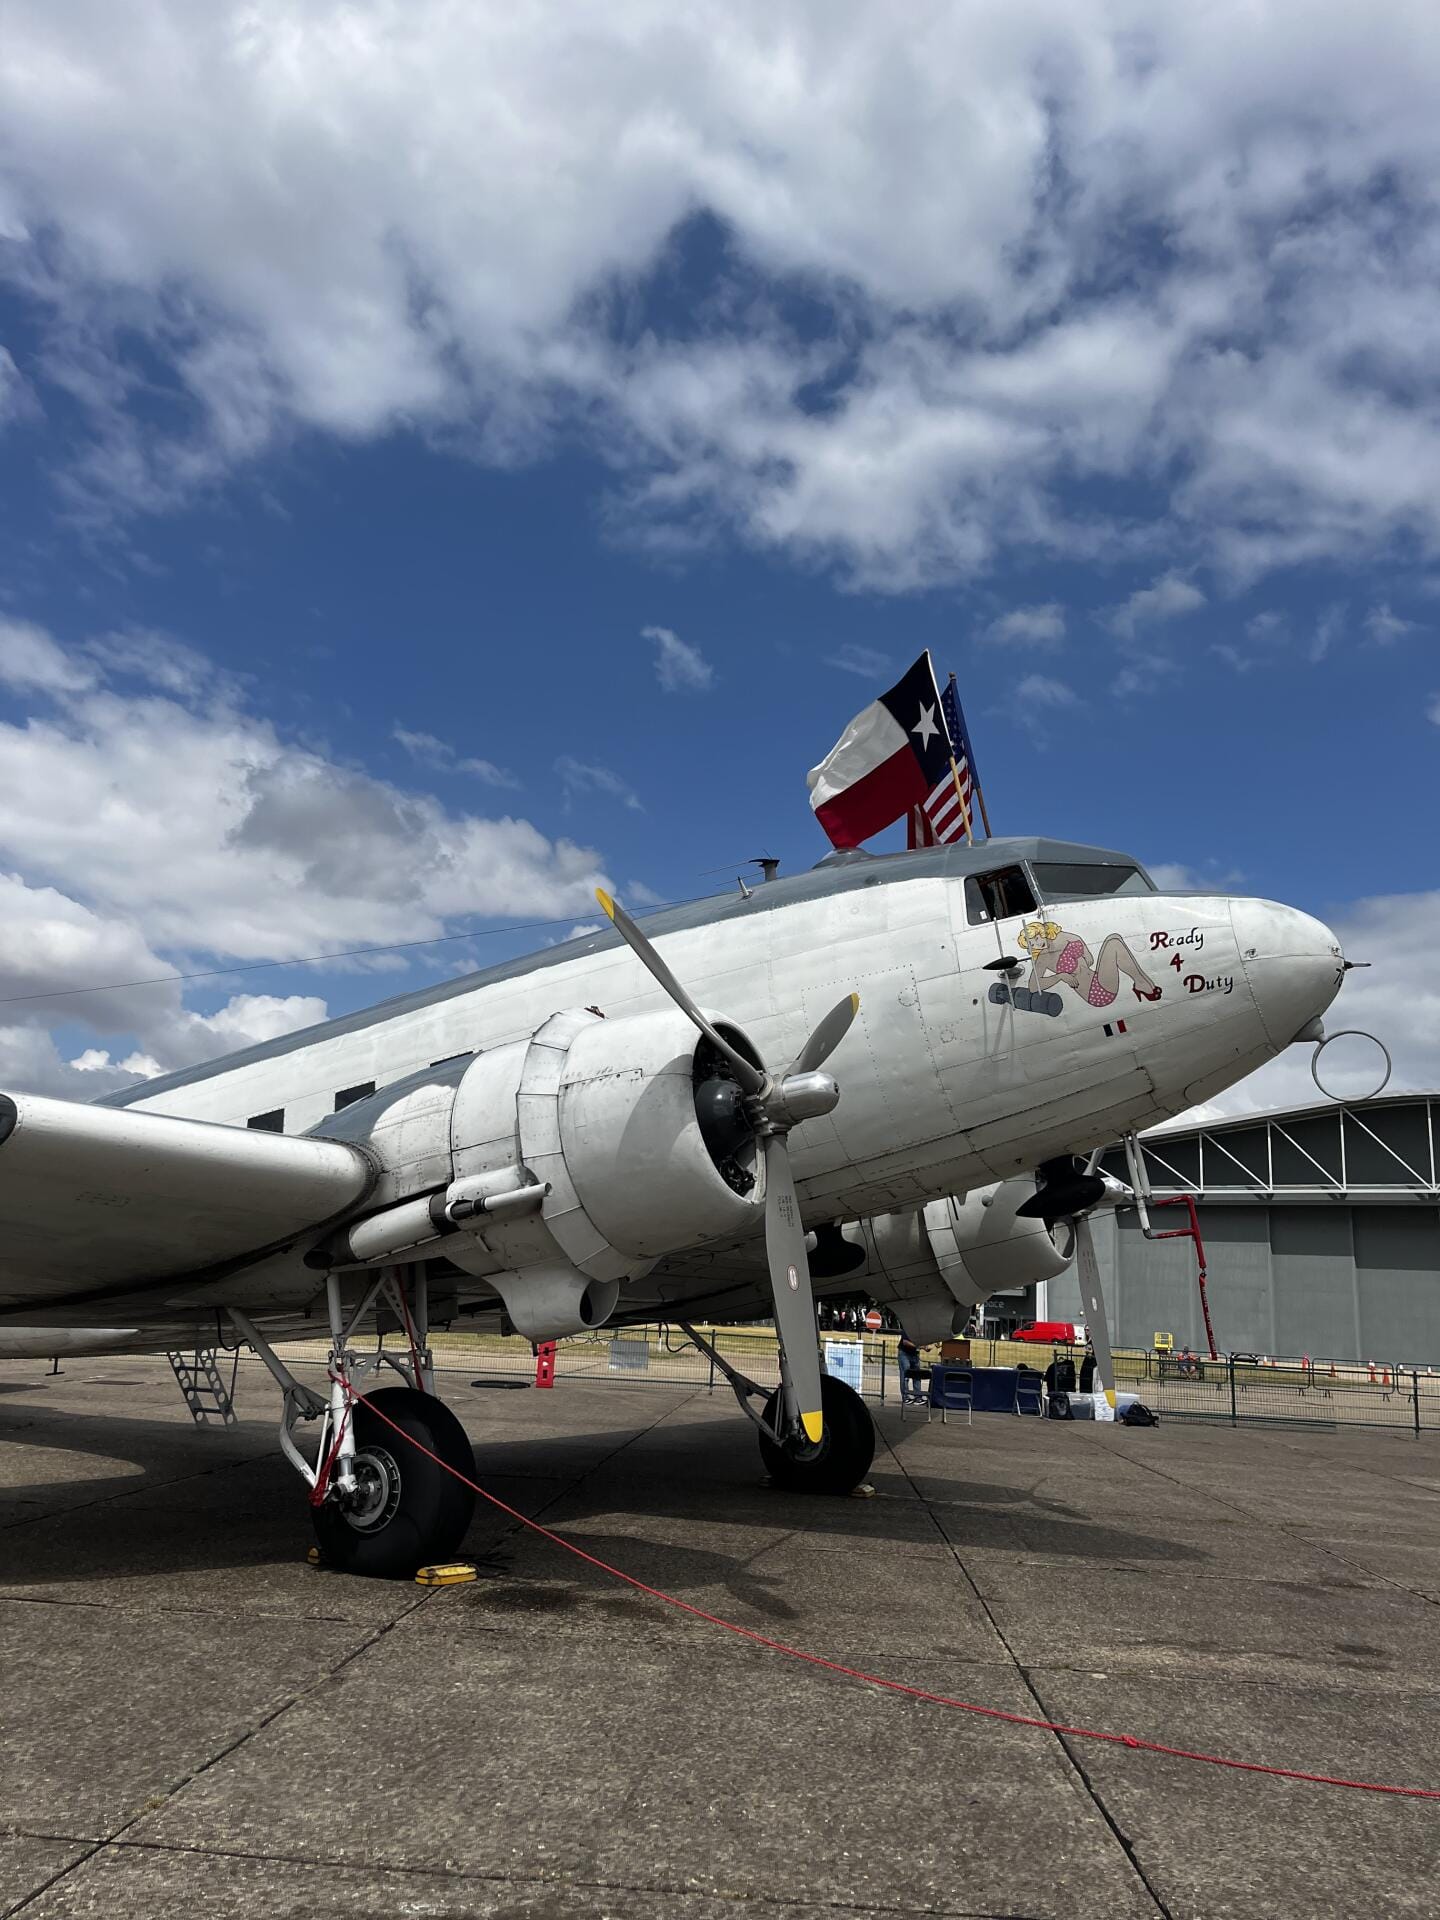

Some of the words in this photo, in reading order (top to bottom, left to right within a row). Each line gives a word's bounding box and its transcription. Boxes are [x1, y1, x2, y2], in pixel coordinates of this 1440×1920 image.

[1150, 927, 1204, 951] Ready
[1170, 952, 1185, 973] 4
[1183, 974, 1233, 995] Duty
